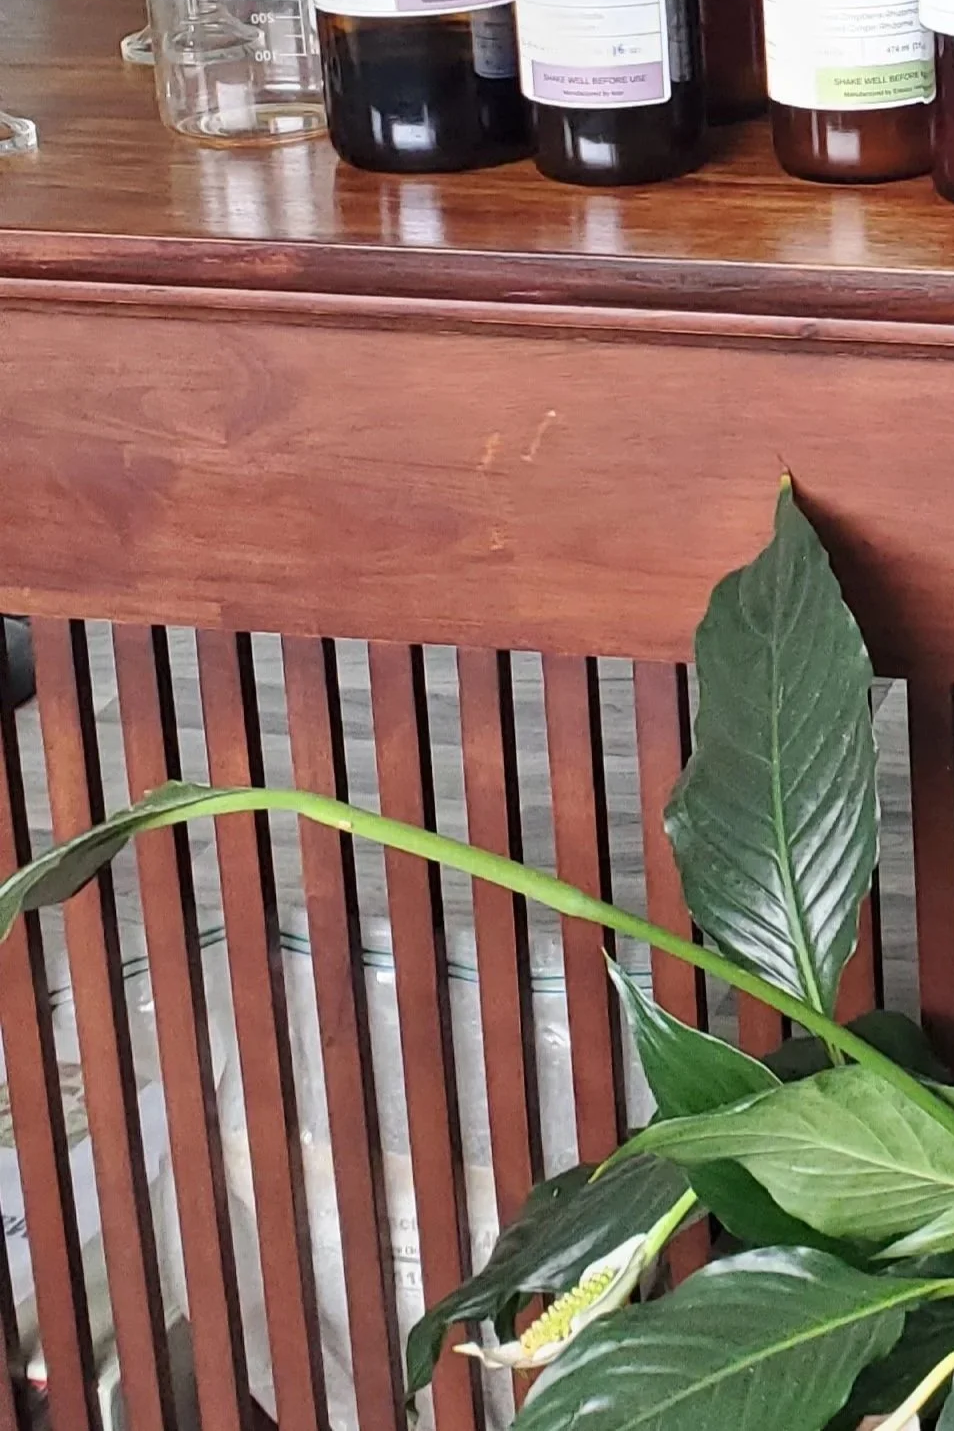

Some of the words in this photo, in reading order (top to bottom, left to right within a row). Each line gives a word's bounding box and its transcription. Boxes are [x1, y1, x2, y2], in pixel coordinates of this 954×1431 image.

[572, 75, 592, 86] WELL
[592, 74, 622, 86] BEFORE
[833, 76, 863, 87] SHAKE
[864, 73, 887, 85] WELL
[888, 70, 920, 83] BEFORE
